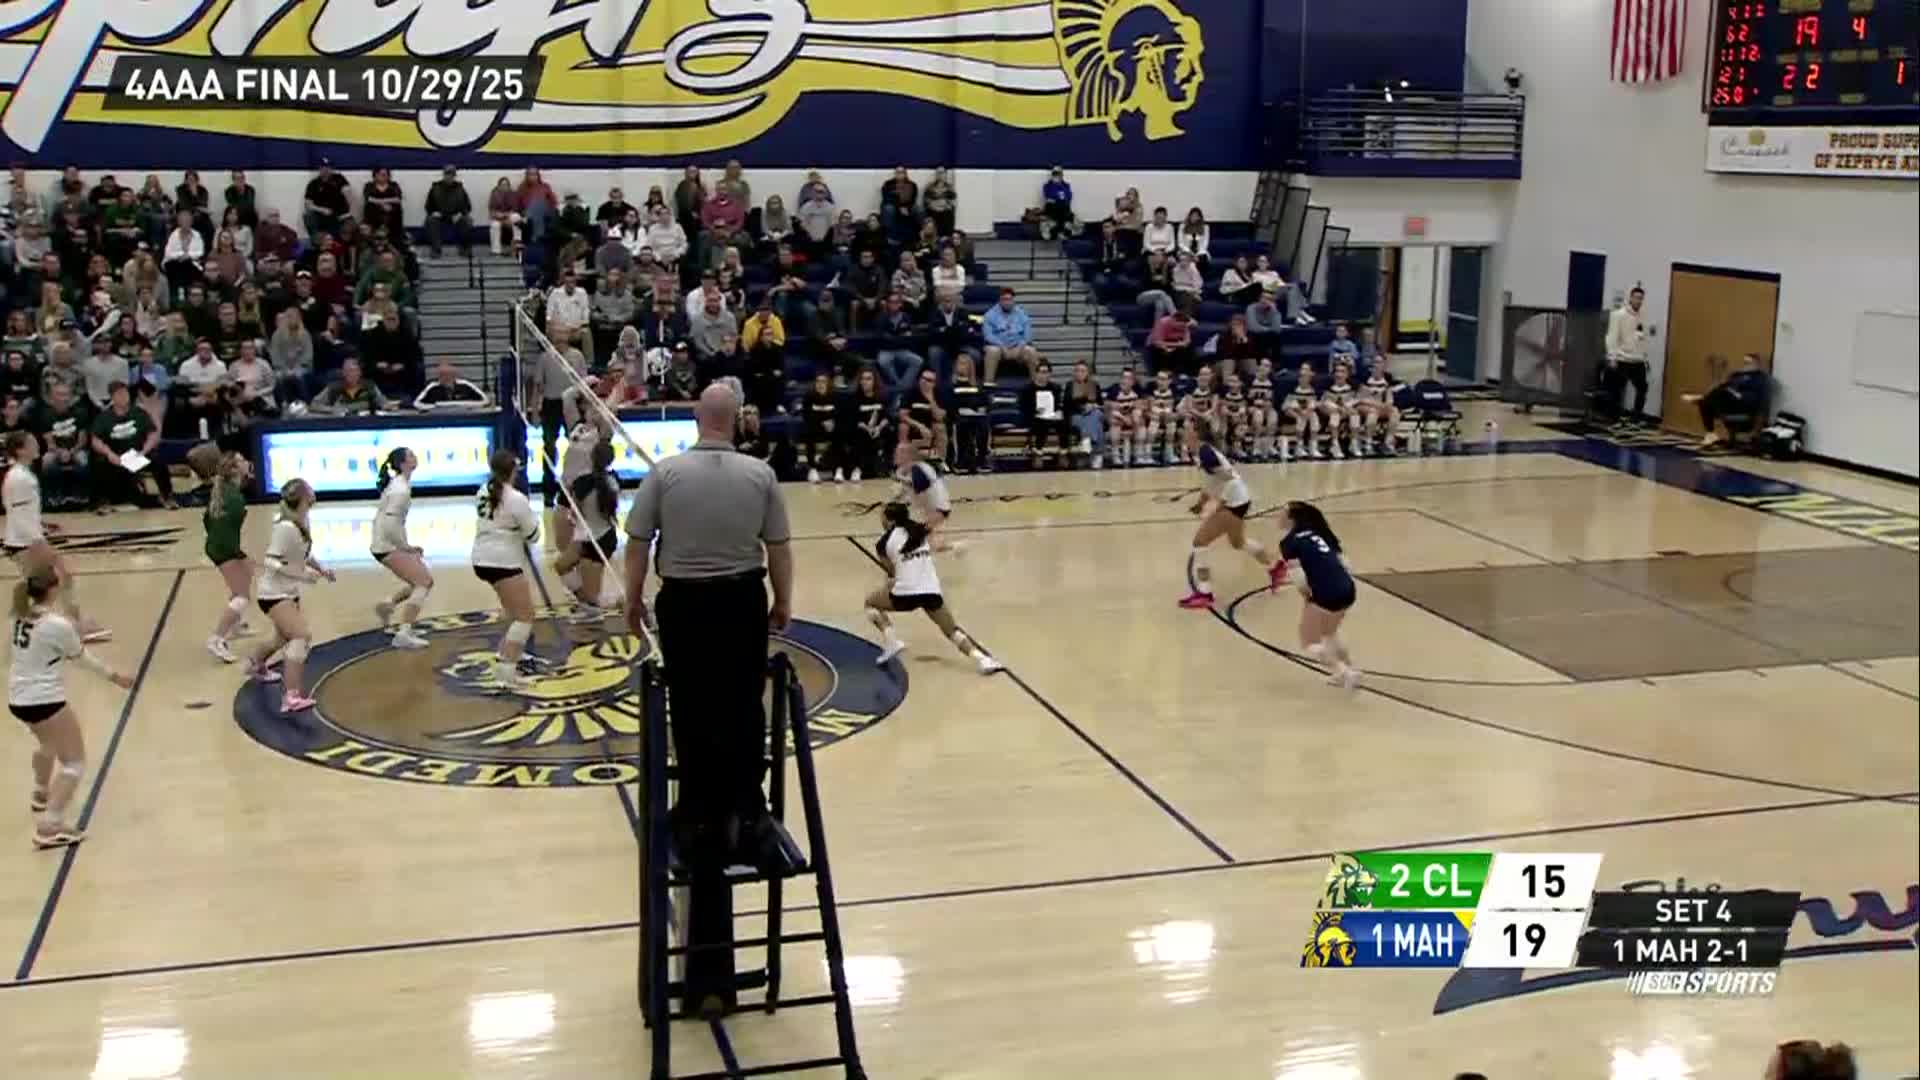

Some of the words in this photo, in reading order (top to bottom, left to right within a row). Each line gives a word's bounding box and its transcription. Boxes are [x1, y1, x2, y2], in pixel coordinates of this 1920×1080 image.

[1796, 16, 1819, 46] 19
[1852, 17, 1866, 40] 4
[13, 620, 34, 648] 15
